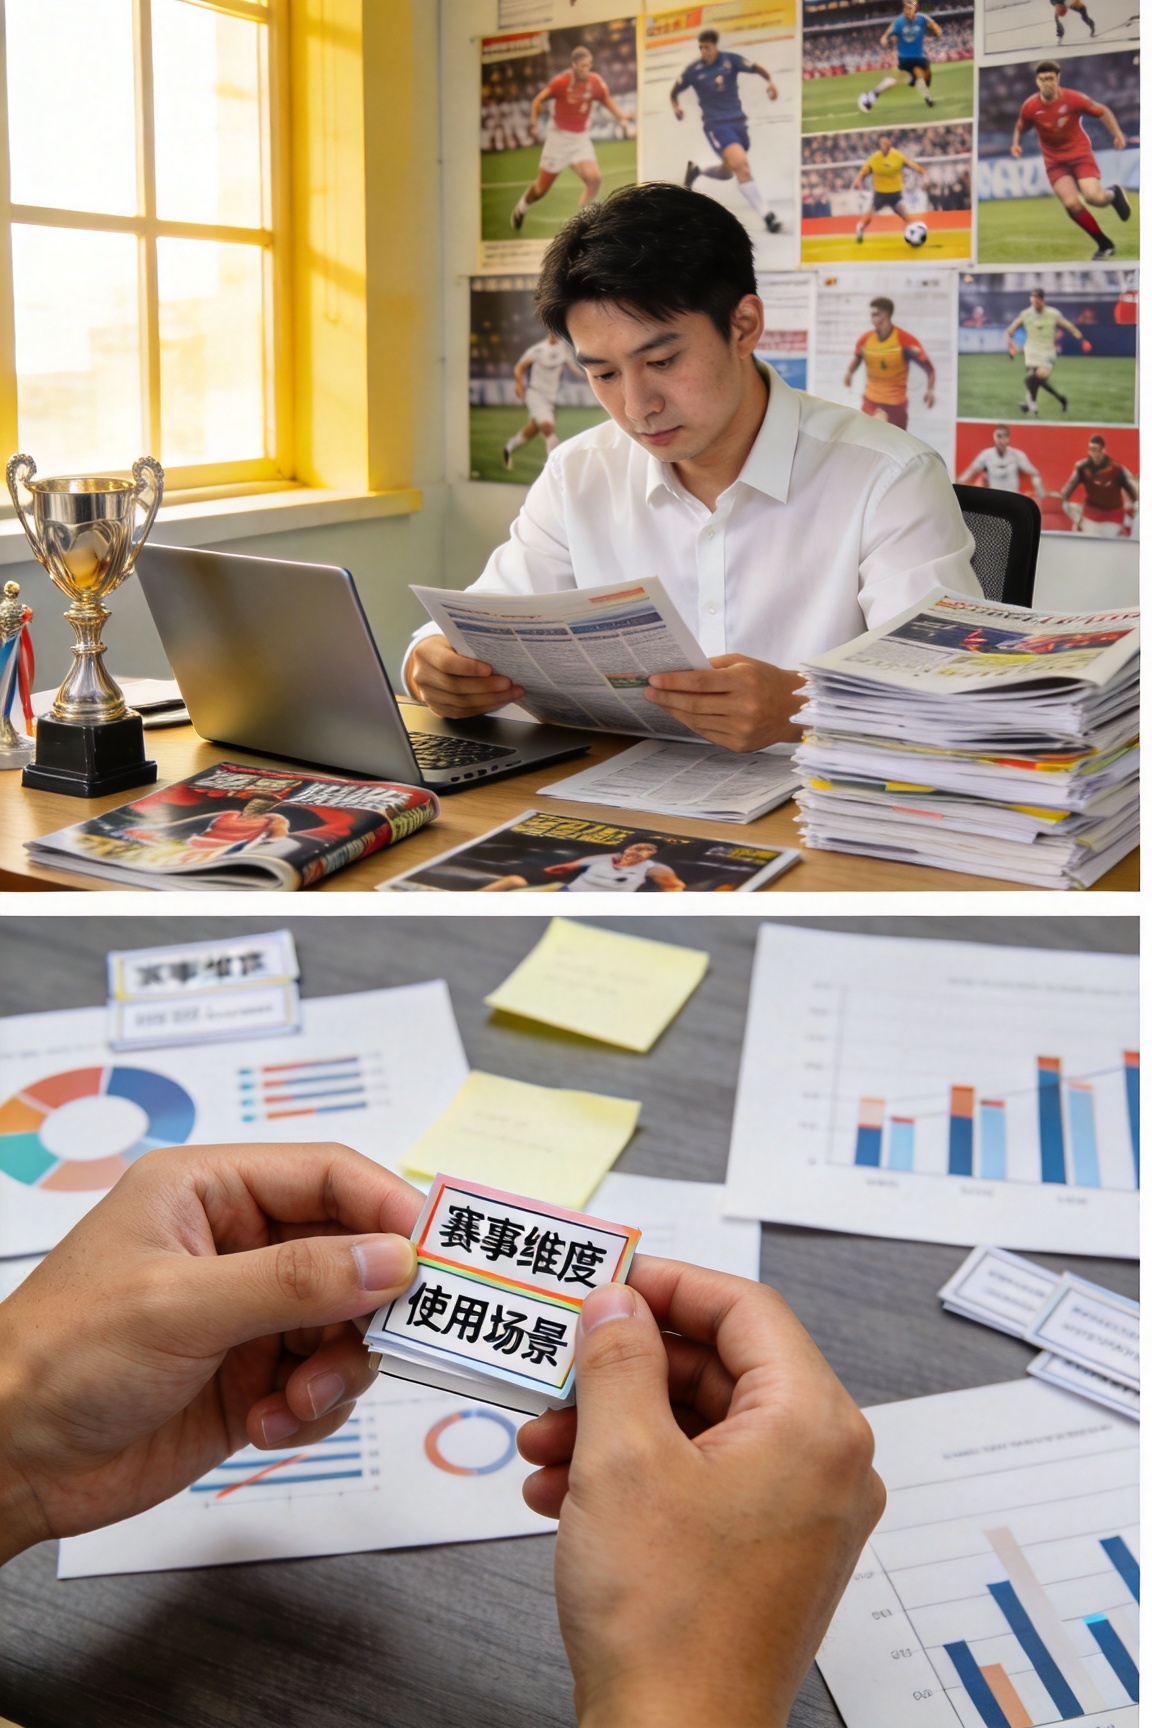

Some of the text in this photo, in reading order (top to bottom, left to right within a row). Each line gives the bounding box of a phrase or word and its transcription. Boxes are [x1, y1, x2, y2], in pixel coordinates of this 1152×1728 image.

[438, 1205, 608, 1290] 赛事维度
[405, 1282, 569, 1368] 使用场景
